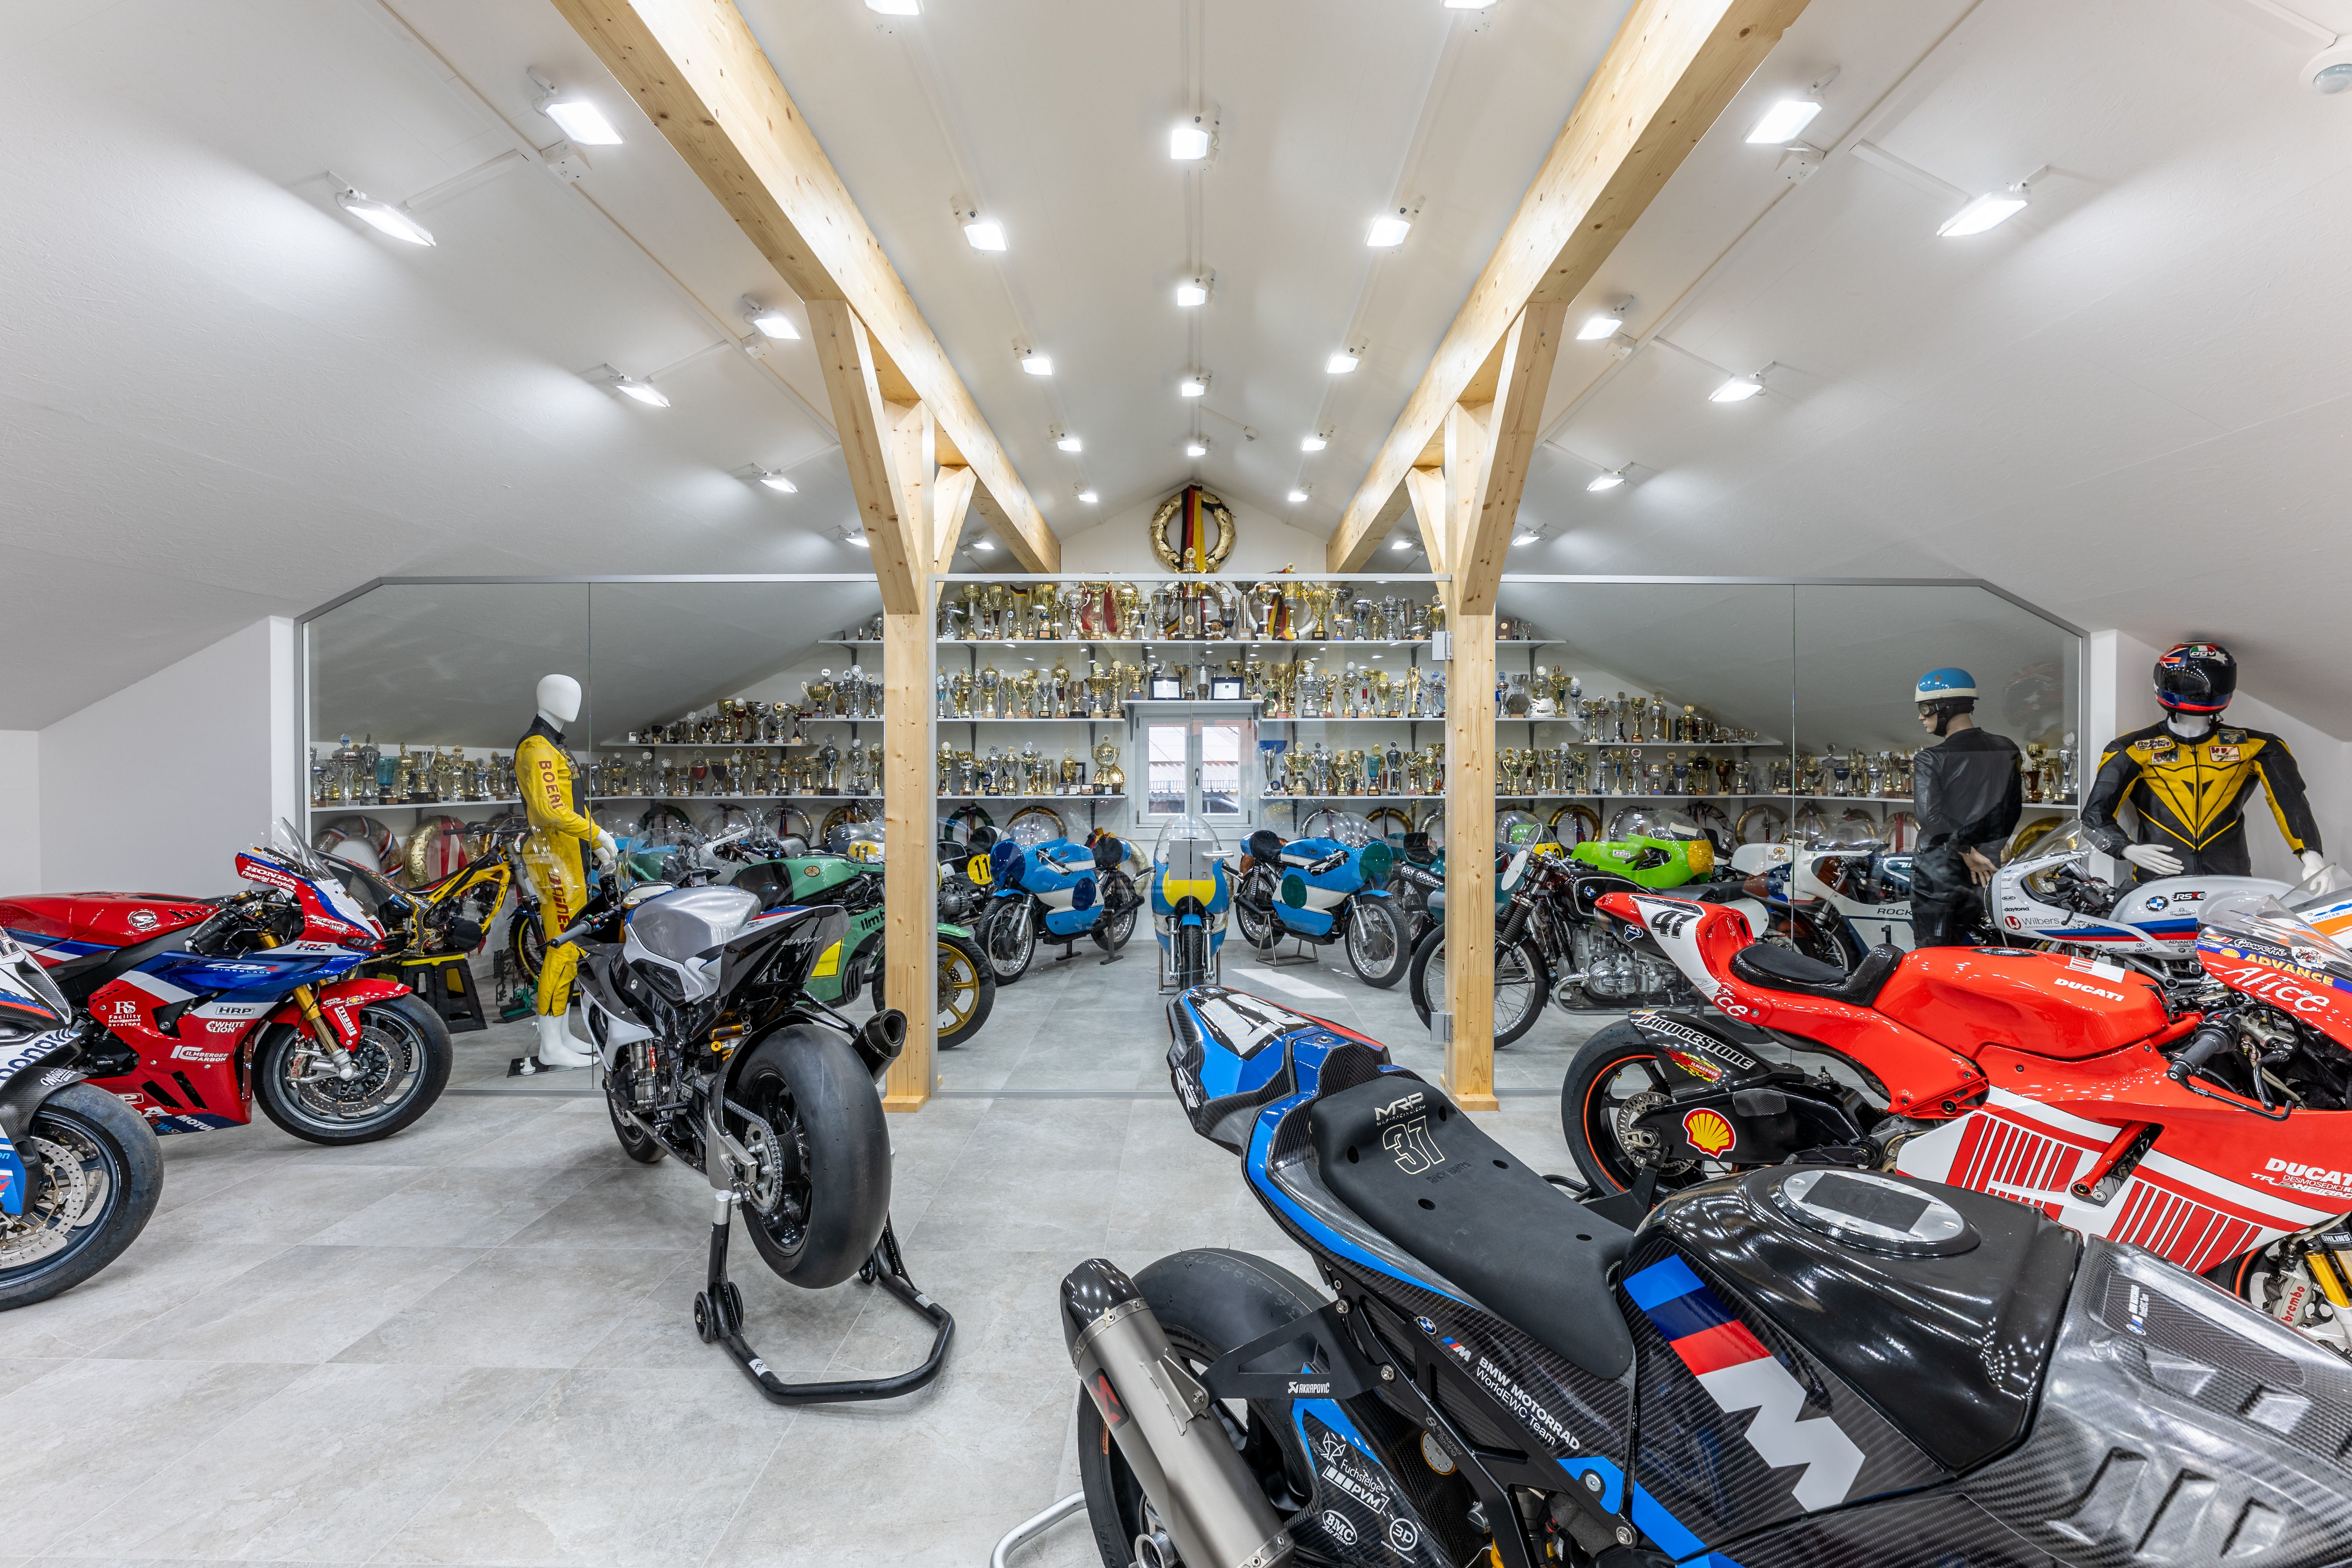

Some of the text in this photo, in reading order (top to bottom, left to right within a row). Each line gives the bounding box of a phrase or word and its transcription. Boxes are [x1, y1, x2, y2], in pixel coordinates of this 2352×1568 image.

[539, 760, 563, 809] BOERI
[241, 871, 295, 891] Financial Services
[245, 866, 297, 885] HONDA
[295, 943, 328, 951] HRC
[782, 936, 823, 946] BMW
[2244, 954, 2334, 987] ADVANCE
[2054, 978, 2125, 1002] DUCATI
[2224, 967, 2330, 1011] Alice
[334, 1006, 358, 1037] PIRELLI
[1635, 1015, 1757, 1070] BRIDGESTONE
[292, 1057, 301, 1075] brembo
[1691, 1062, 1718, 1077] ILMBERGER
[1374, 1092, 1424, 1120] MRP
[176, 1115, 215, 1131] MOTUL
[1383, 1116, 1445, 1174] 37
[2283, 1175, 2343, 1190] DESMOSEDICI
[2321, 1234, 2350, 1242] ÖHLINS
[2281, 1285, 2305, 1322] brembo
[1299, 1382, 1330, 1393] AKRAPOVIČ
[1476, 1367, 1556, 1446] WorldEWC Team
[1479, 1357, 1580, 1450] BMW MOTORRAD
[1322, 1524, 1350, 1546] Air Filter
[1326, 1512, 1354, 1542] BMC
[1393, 1524, 1413, 1543] 3D
[1396, 1551, 1415, 1564] MANAGEMENT
